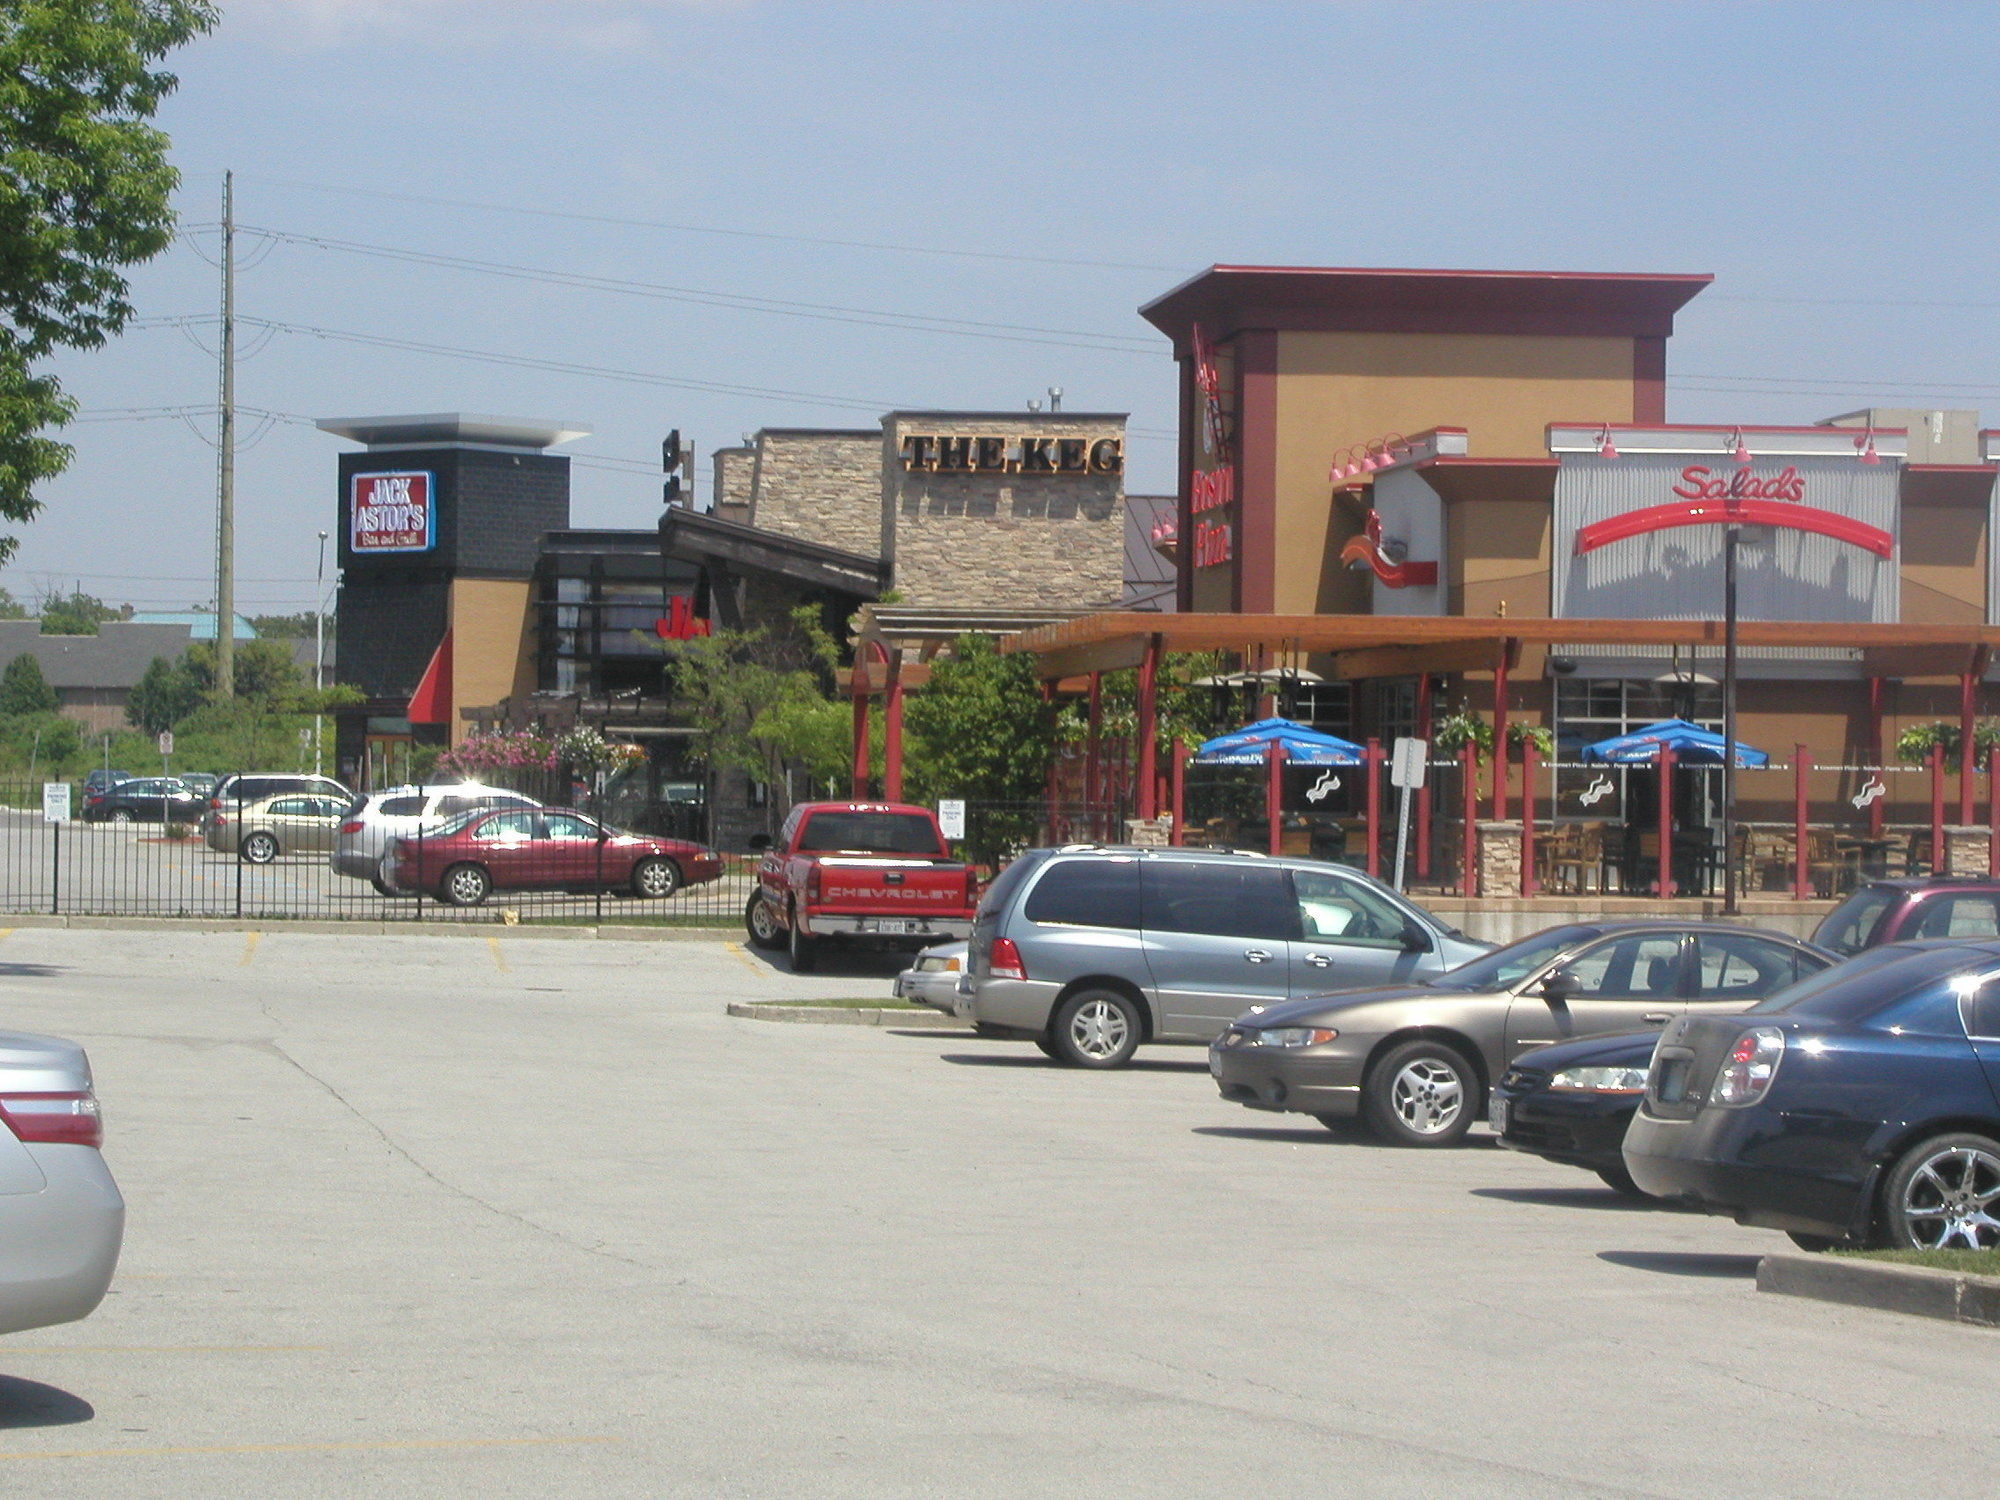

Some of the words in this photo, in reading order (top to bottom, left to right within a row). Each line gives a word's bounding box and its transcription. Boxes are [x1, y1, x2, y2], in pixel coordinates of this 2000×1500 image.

[901, 434, 1007, 474] THE
[1015, 435, 1124, 475] KEG
[367, 478, 412, 505] JACK
[1672, 465, 1806, 502] Salads
[355, 503, 425, 532] ASTOR'S
[827, 887, 959, 899] CHEVROLET
